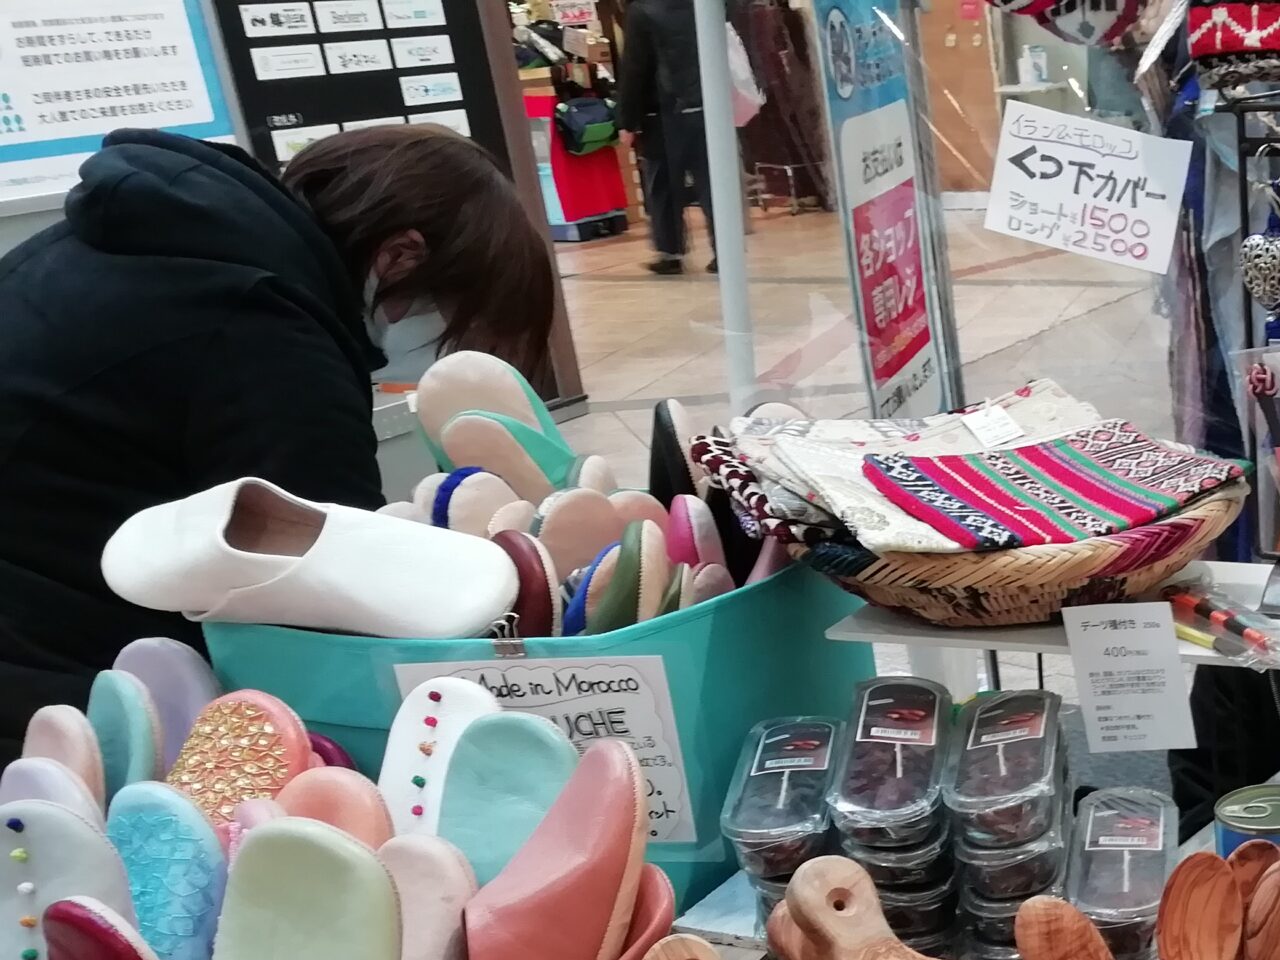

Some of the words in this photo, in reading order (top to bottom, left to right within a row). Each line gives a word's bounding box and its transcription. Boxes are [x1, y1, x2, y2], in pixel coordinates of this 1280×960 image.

[1007, 145, 1166, 208] くつ下カバー
[529, 682, 552, 697] in
[553, 671, 639, 697] Morocco
